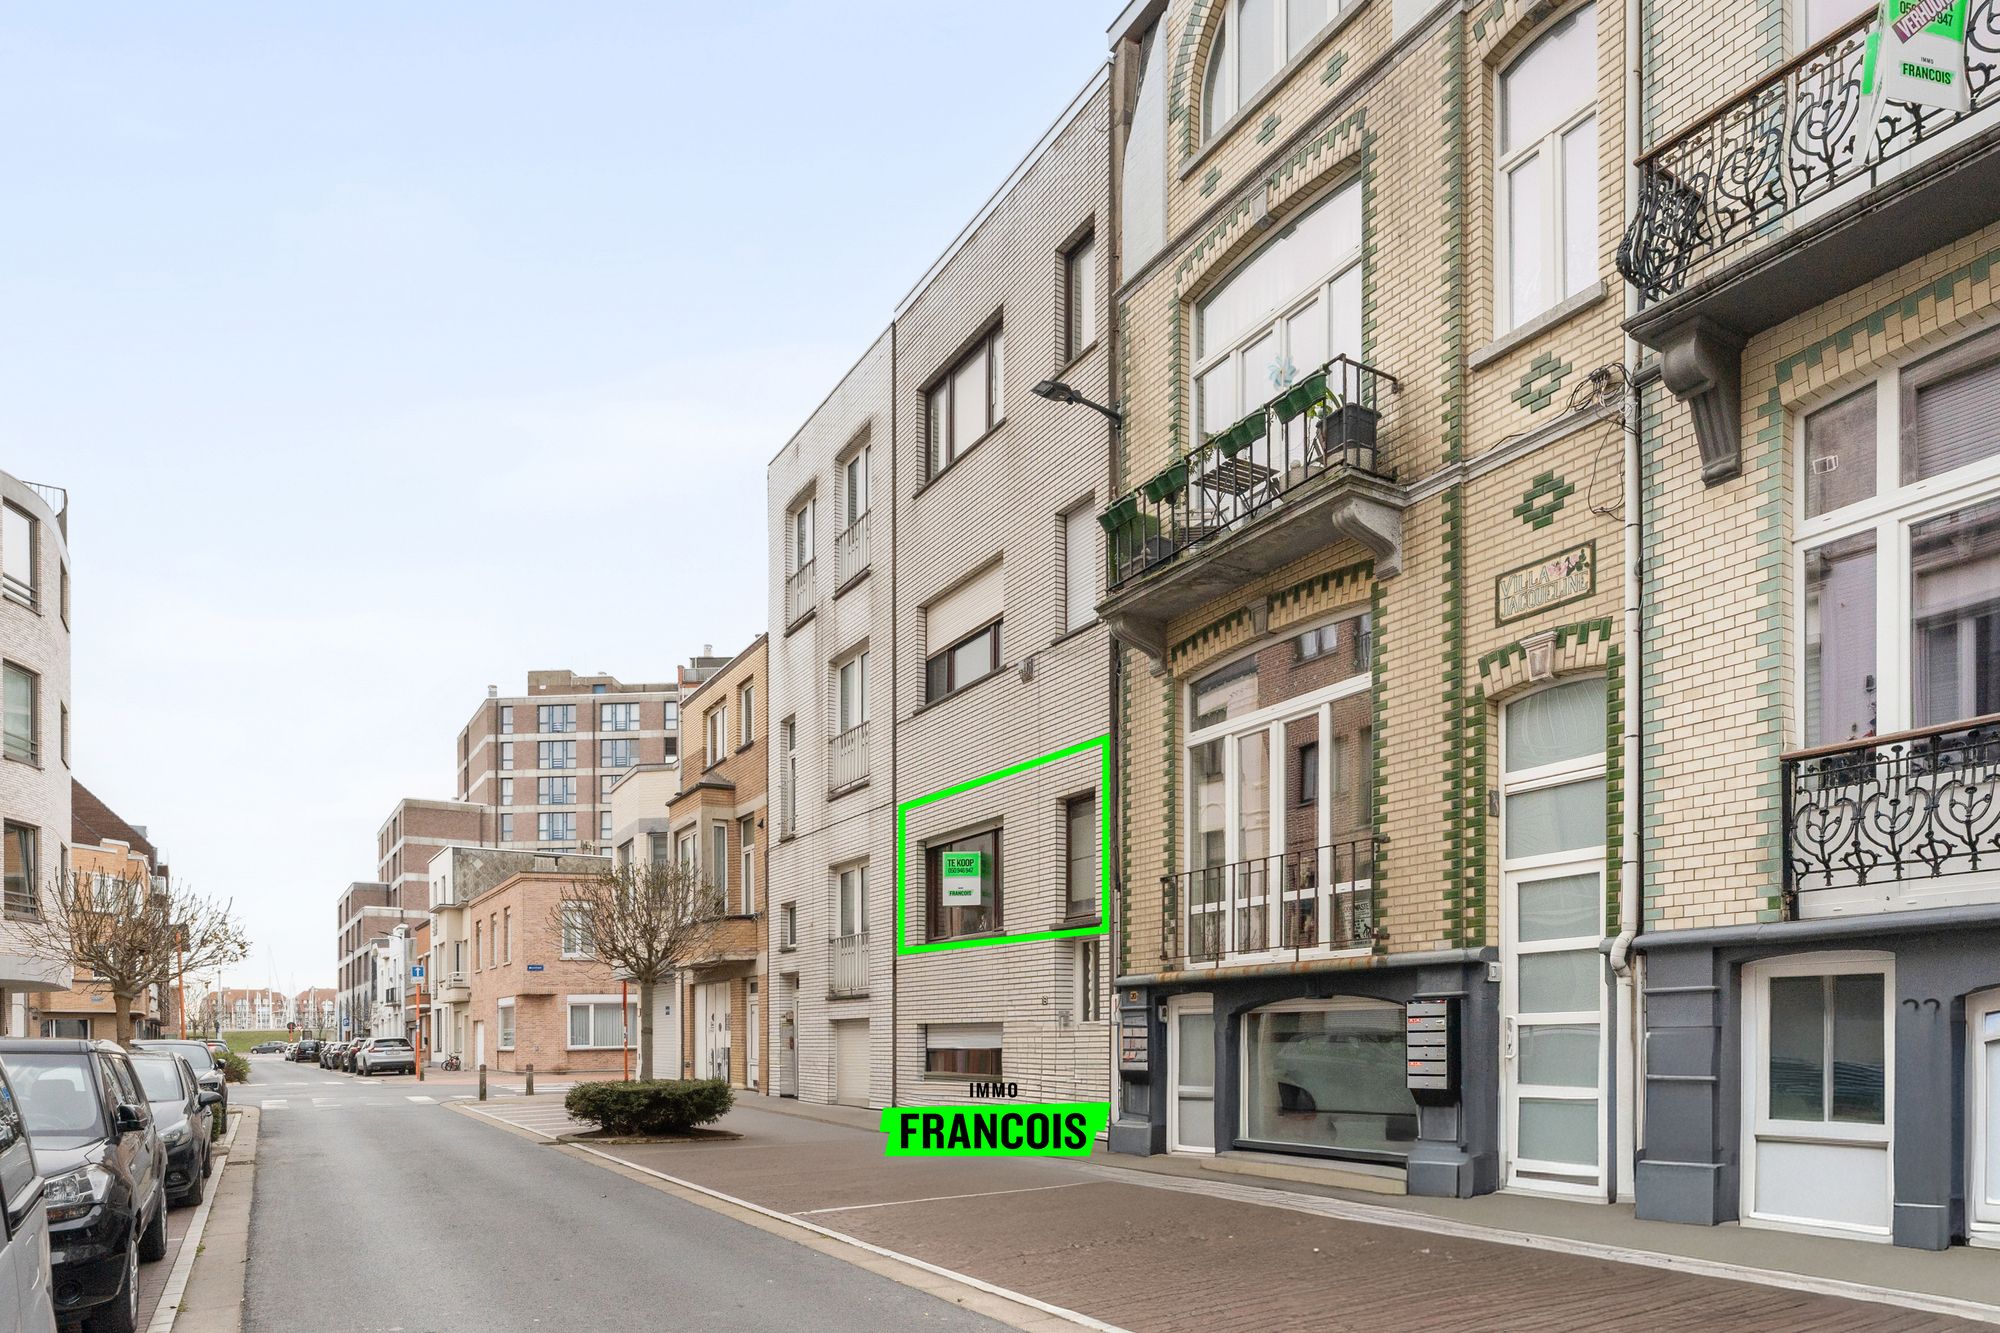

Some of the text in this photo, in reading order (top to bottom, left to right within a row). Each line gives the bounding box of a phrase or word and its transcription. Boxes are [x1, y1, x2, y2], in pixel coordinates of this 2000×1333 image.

[1921, 56, 1934, 64] IMMO
[1902, 63, 1951, 85] FRANCOIS
[1501, 565, 1549, 597] VILLA
[1503, 571, 1589, 617] JACQUELINE
[947, 859, 974, 867] TE KOOP
